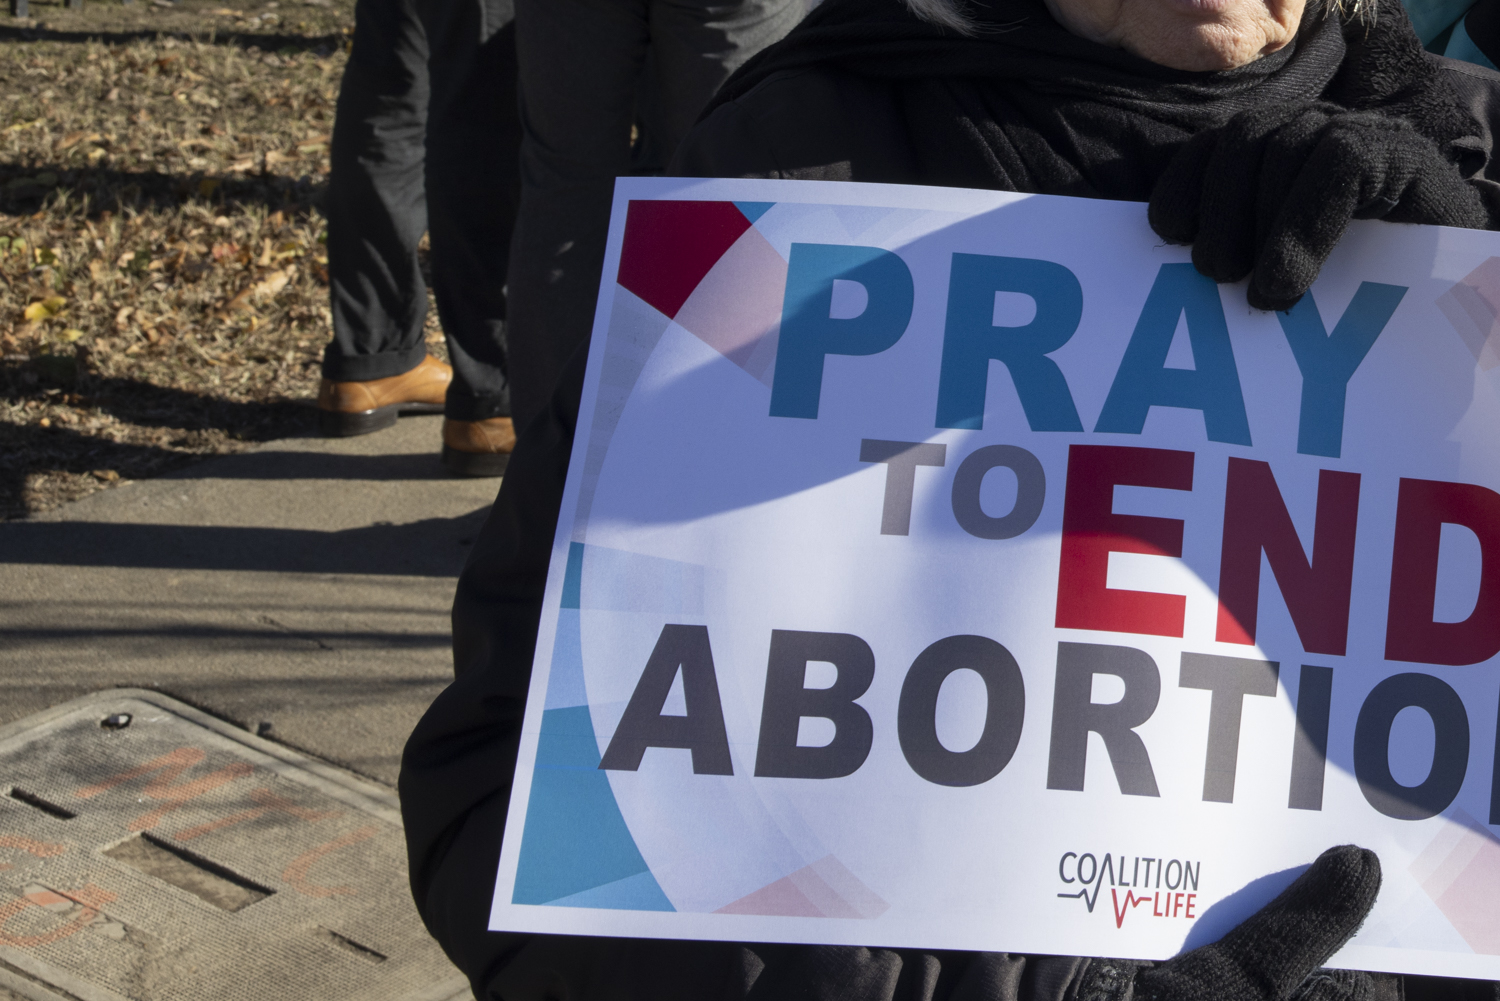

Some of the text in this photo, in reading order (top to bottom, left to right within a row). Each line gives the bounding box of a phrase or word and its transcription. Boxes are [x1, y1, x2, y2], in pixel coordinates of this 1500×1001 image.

[768, 242, 1410, 459] PRAY
[859, 438, 1046, 540] TO
[1058, 851, 1200, 893] COALITION
[1153, 891, 1197, 919] LIFE
